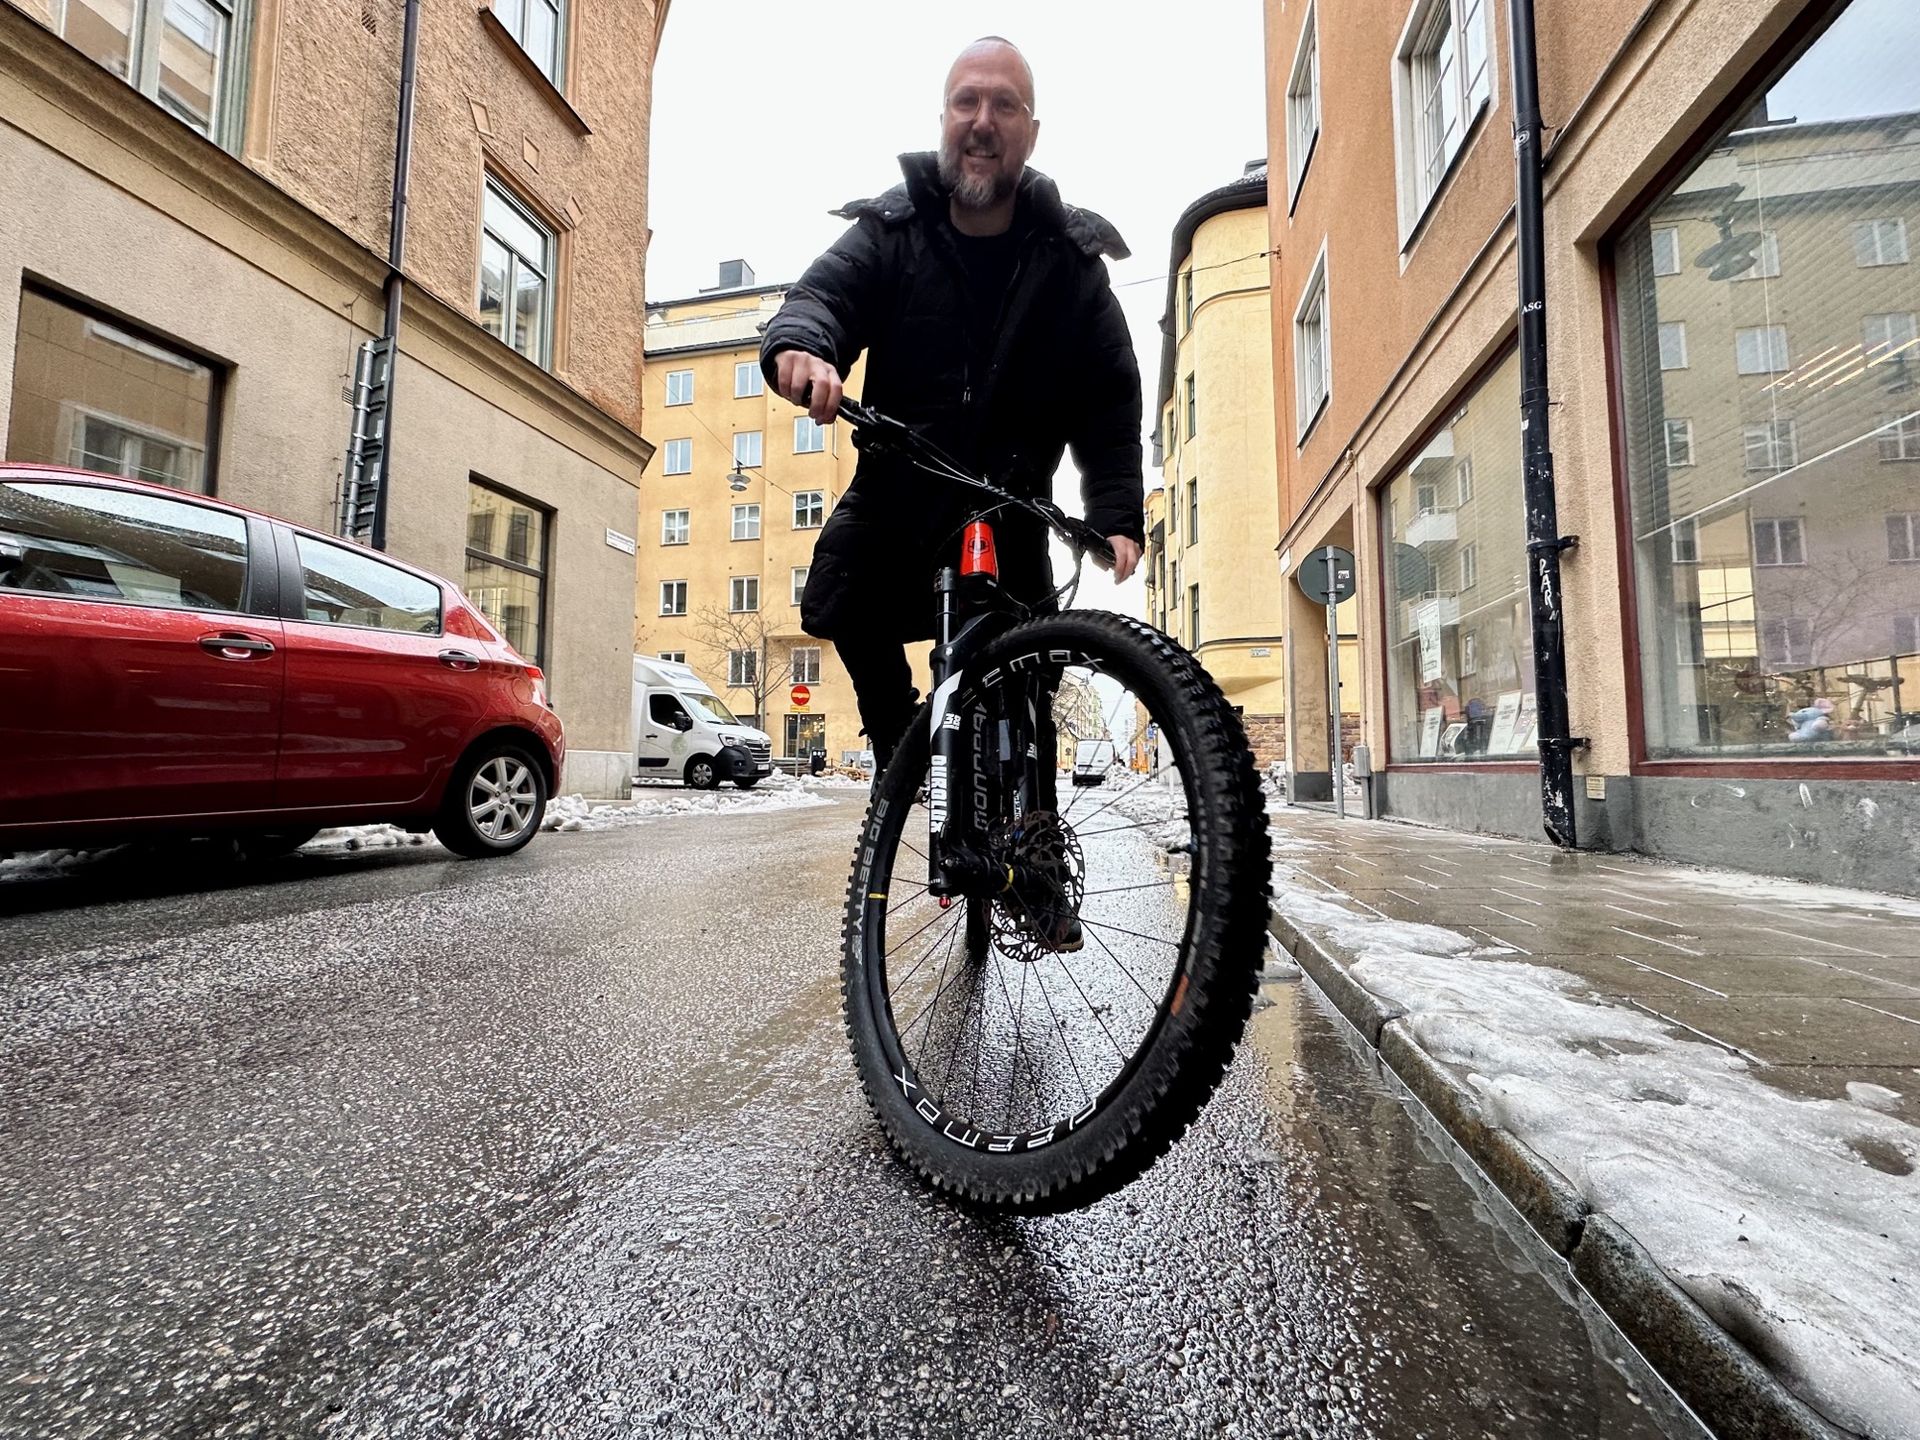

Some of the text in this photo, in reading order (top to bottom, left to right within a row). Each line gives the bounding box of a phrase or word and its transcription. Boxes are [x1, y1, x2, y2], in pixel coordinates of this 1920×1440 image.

[1521, 300, 1542, 315] ASG
[869, 798, 890, 842] BIG
[930, 754, 948, 834] DUROLUX
[853, 846, 875, 932] BETTY
